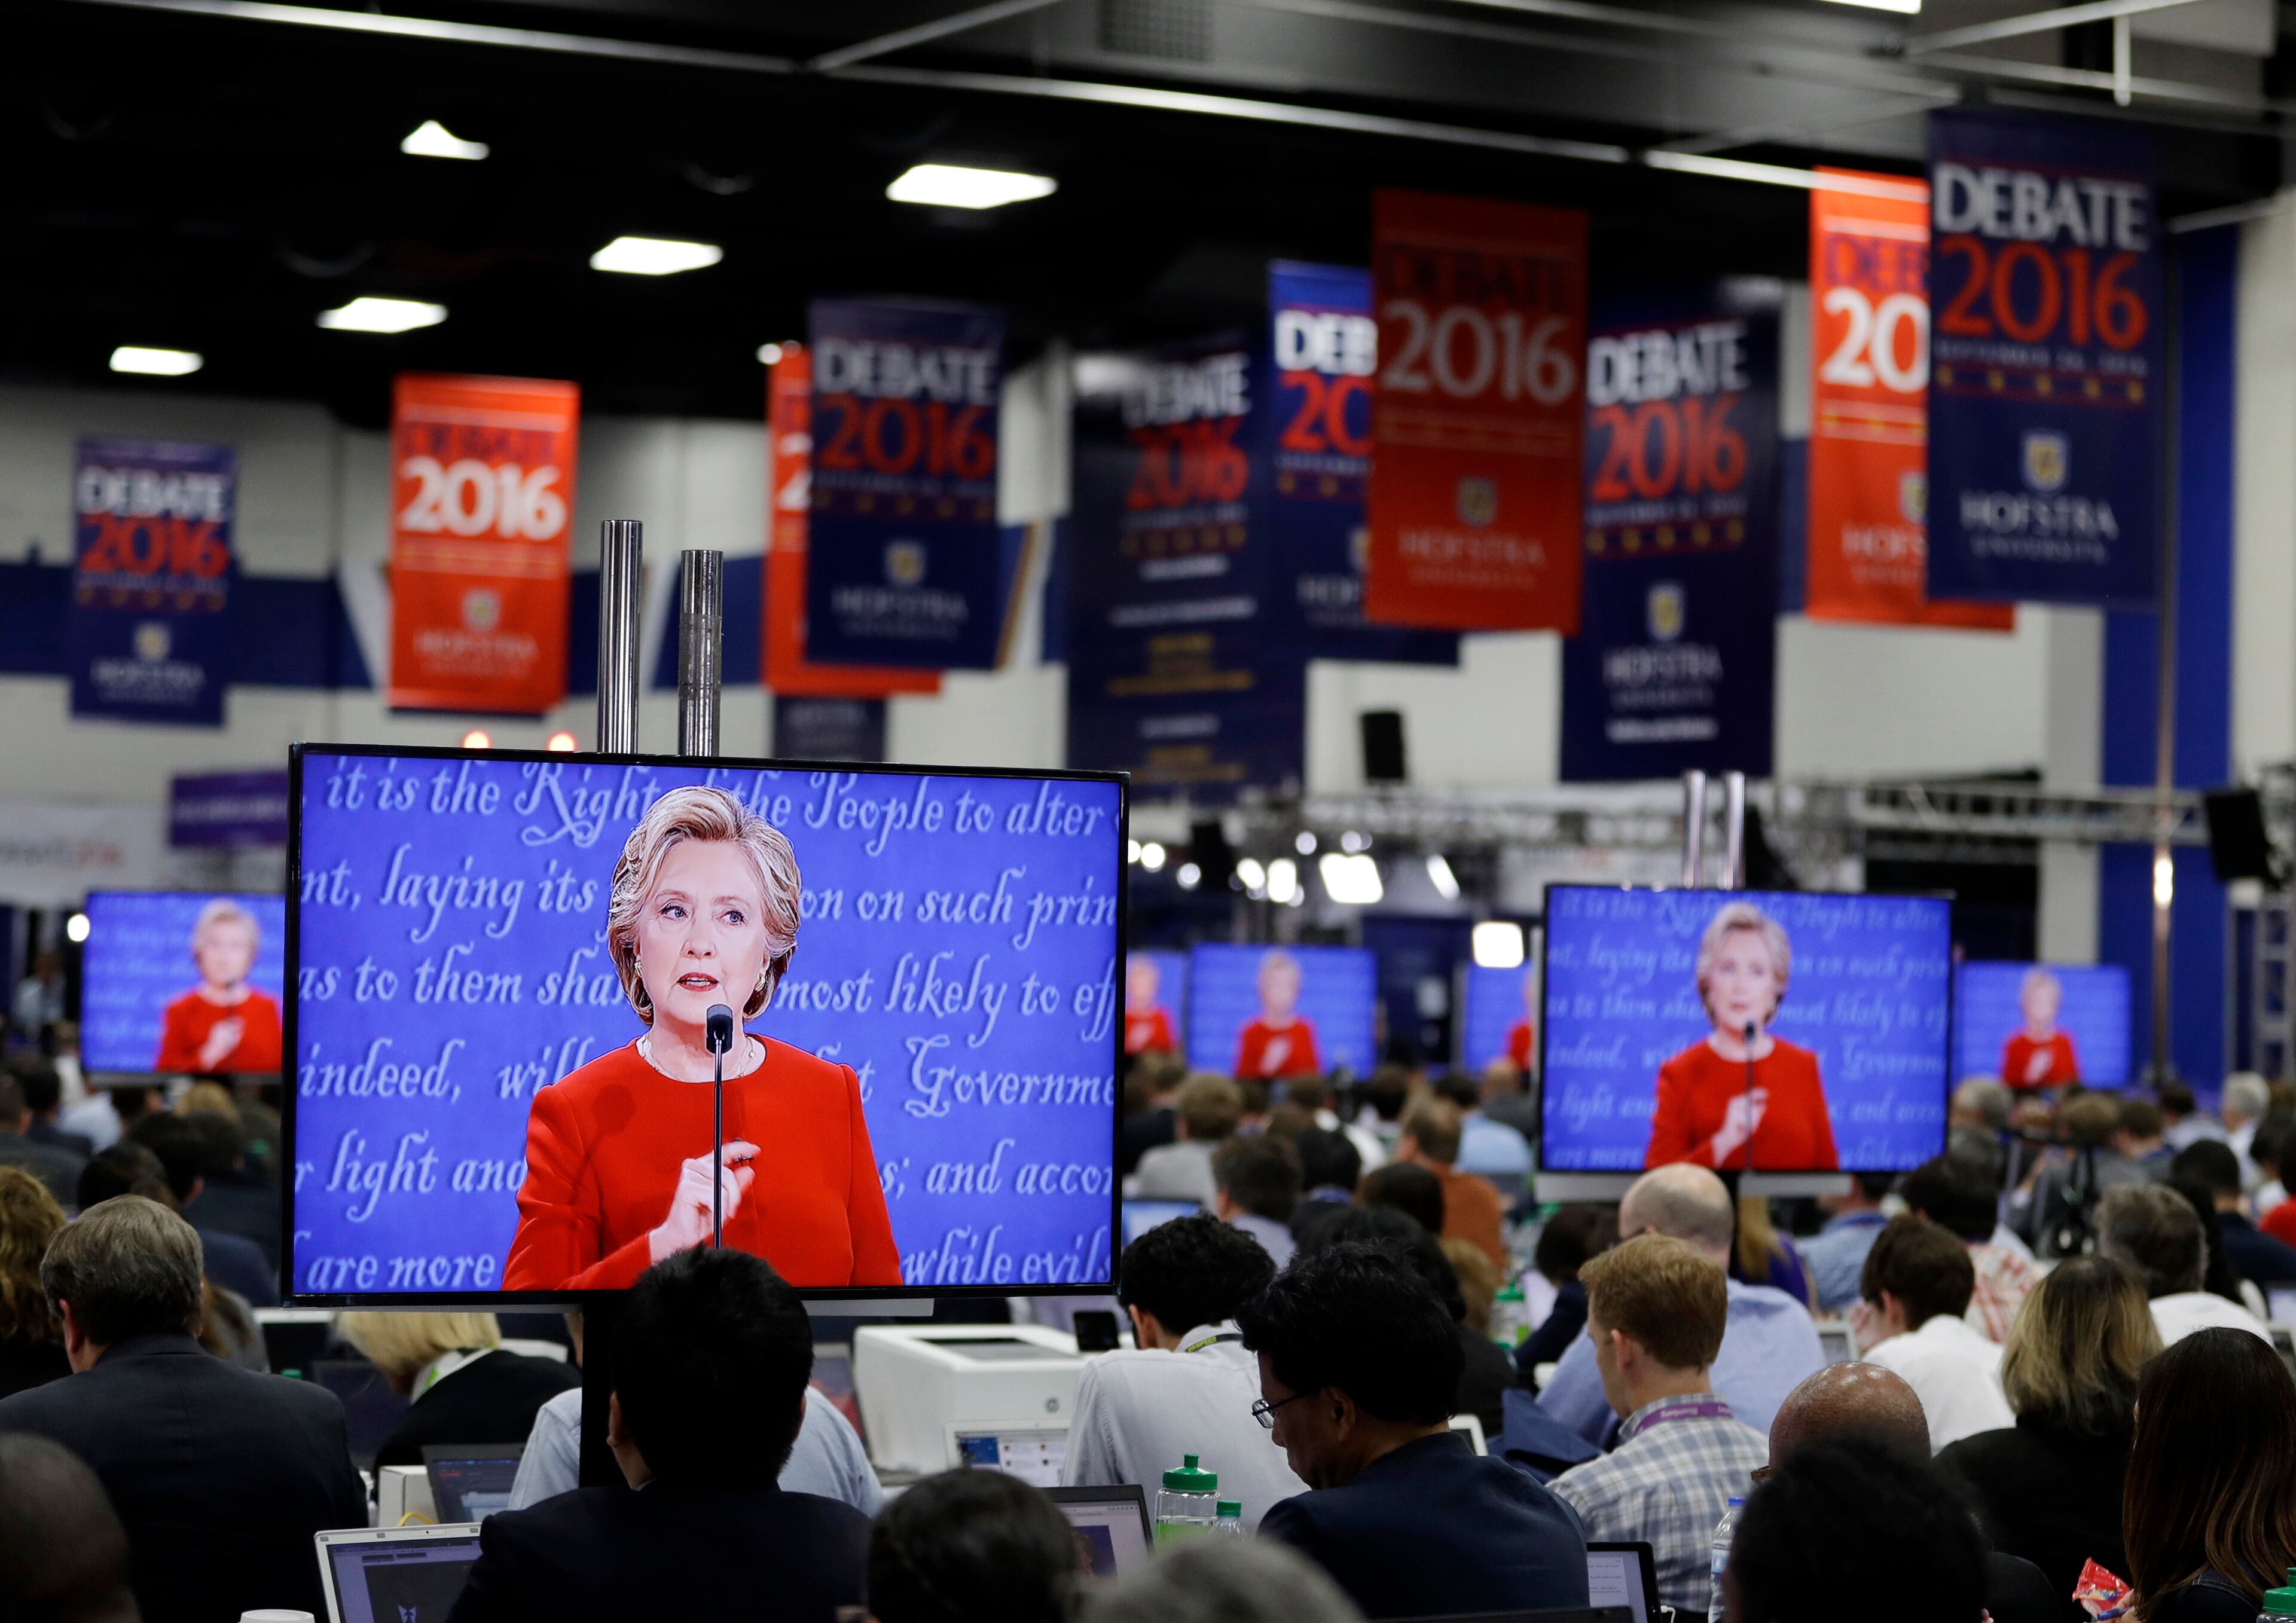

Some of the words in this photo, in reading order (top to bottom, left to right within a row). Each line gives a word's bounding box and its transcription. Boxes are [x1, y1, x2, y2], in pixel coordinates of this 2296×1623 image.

[1934, 162, 2151, 251] DEBATE
[1937, 234, 2148, 350] 2016
[819, 341, 997, 404] DEBATE
[1380, 298, 1576, 405] 2016
[1588, 322, 1747, 405] DEBATE
[818, 393, 993, 479] 2016
[1590, 396, 1747, 503] 2016
[80, 469, 227, 521] DEBATE
[399, 454, 567, 540] 2016
[1961, 493, 2119, 540] HOFSTRA
[80, 515, 229, 579] 2016
[326, 756, 367, 810] it
[377, 757, 420, 810] is
[430, 759, 500, 815] the
[515, 761, 660, 847] Right
[804, 772, 944, 857] People
[955, 790, 994, 833] to
[1007, 781, 1106, 836] alter
[380, 842, 524, 944] laying
[538, 860, 599, 913] its
[857, 888, 903, 921] on
[917, 866, 1026, 924] such
[1013, 876, 1116, 950] prin
[356, 956, 399, 1002] to
[414, 941, 522, 1004] them
[775, 969, 874, 1013] most
[886, 950, 1008, 1048] likely
[1021, 971, 1060, 1015] to
[300, 1037, 465, 1103] indeed,
[326, 1129, 440, 1222] light
[926, 1138, 1015, 1195] and
[307, 1254, 379, 1290] are
[388, 1253, 496, 1288] more
[901, 1225, 1012, 1285] while
